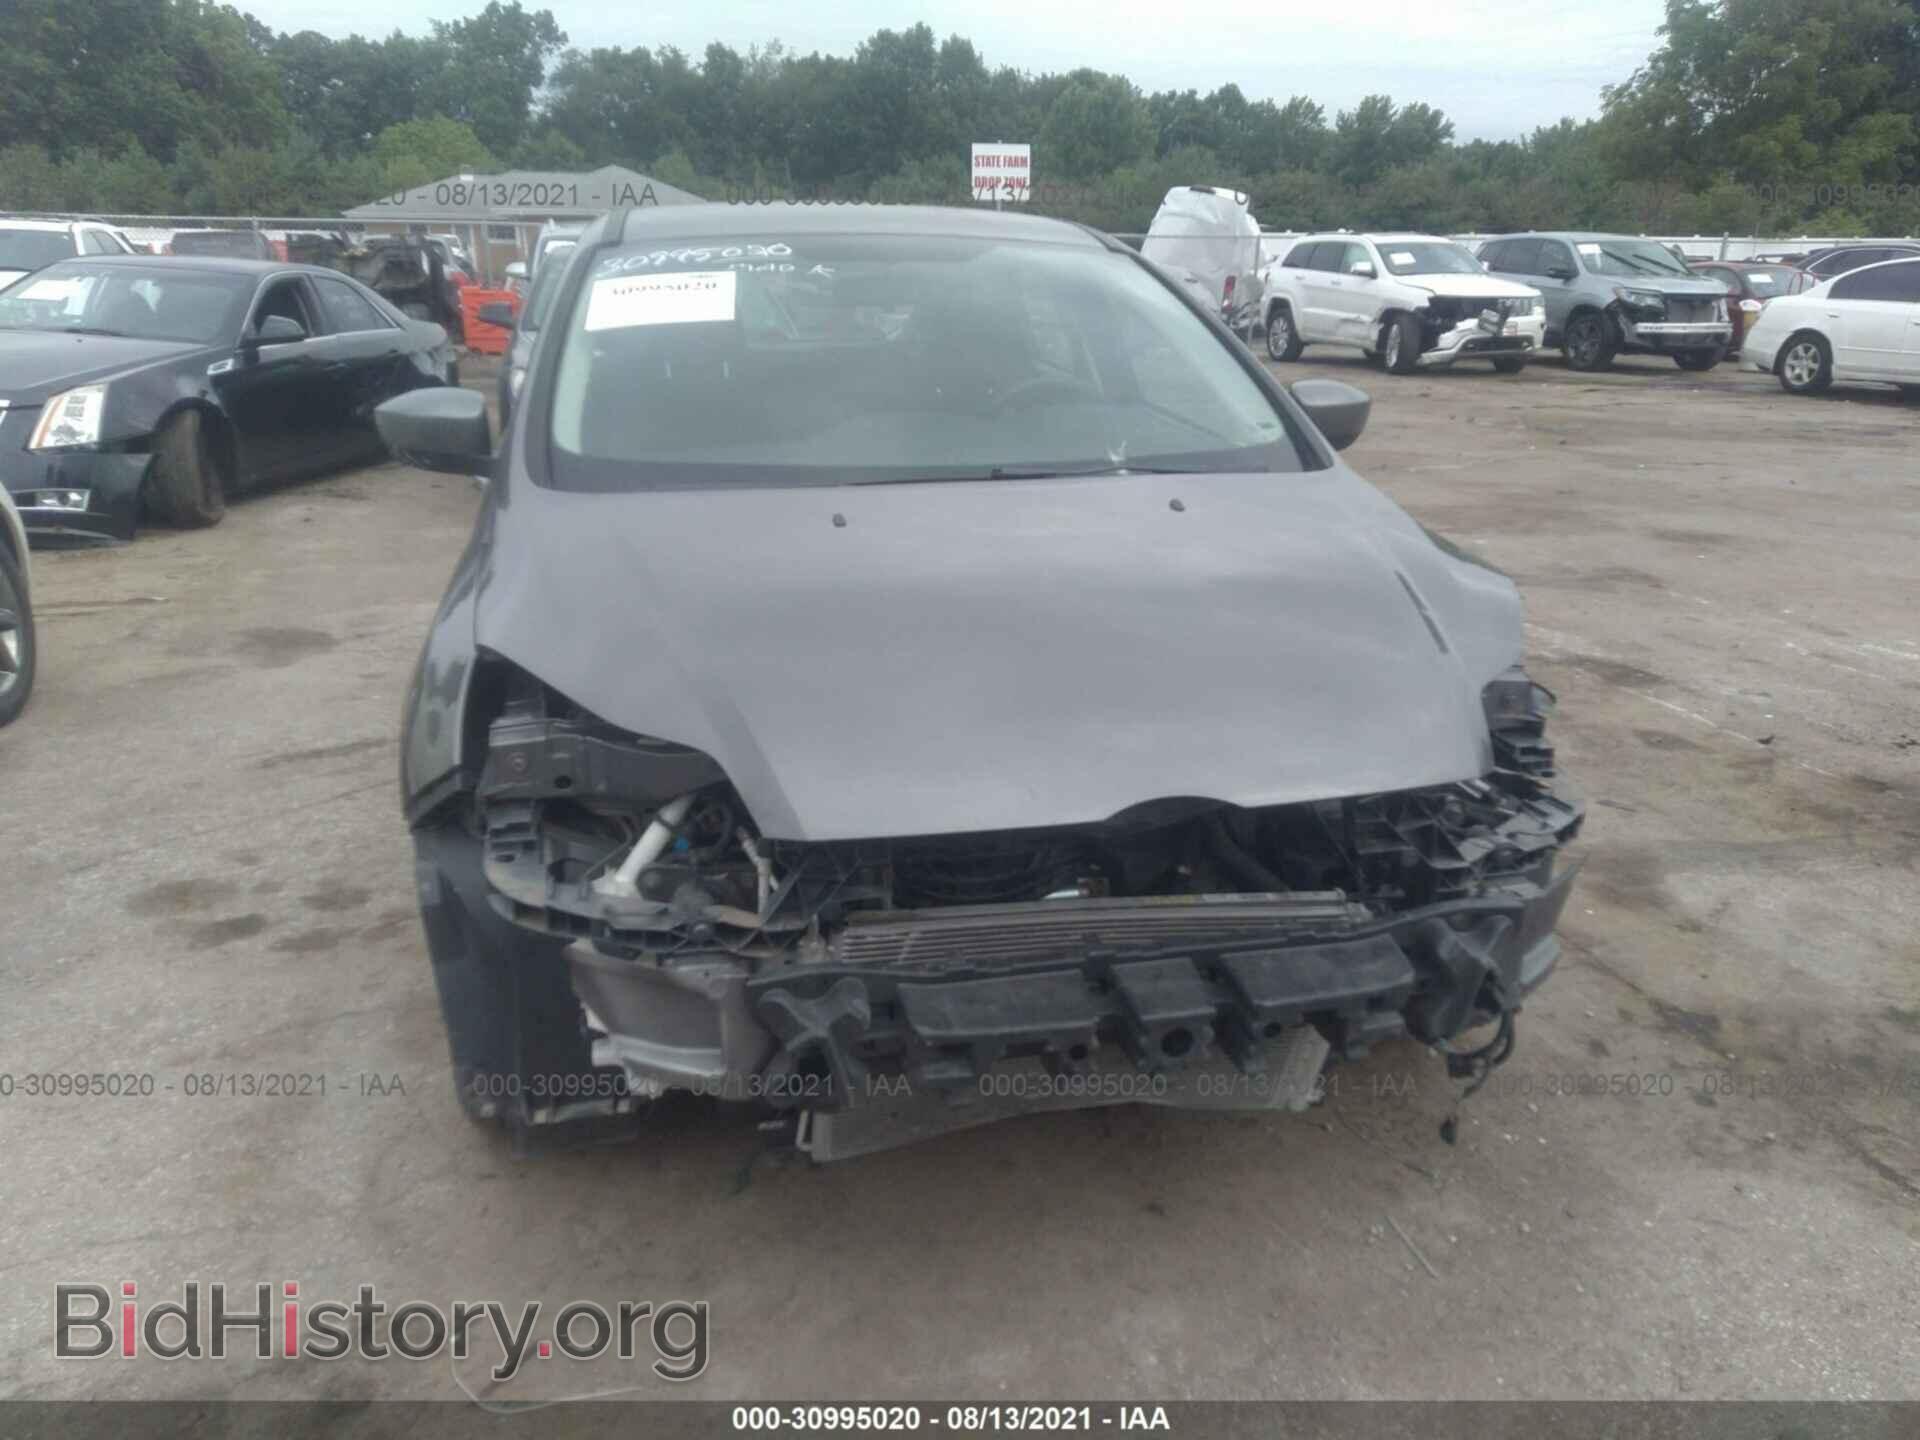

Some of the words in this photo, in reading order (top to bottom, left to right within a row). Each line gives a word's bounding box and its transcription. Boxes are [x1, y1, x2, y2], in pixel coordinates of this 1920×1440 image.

[975, 155, 1001, 168] STATE
[1003, 155, 1028, 168] FARM
[975, 176, 1001, 188] DROP
